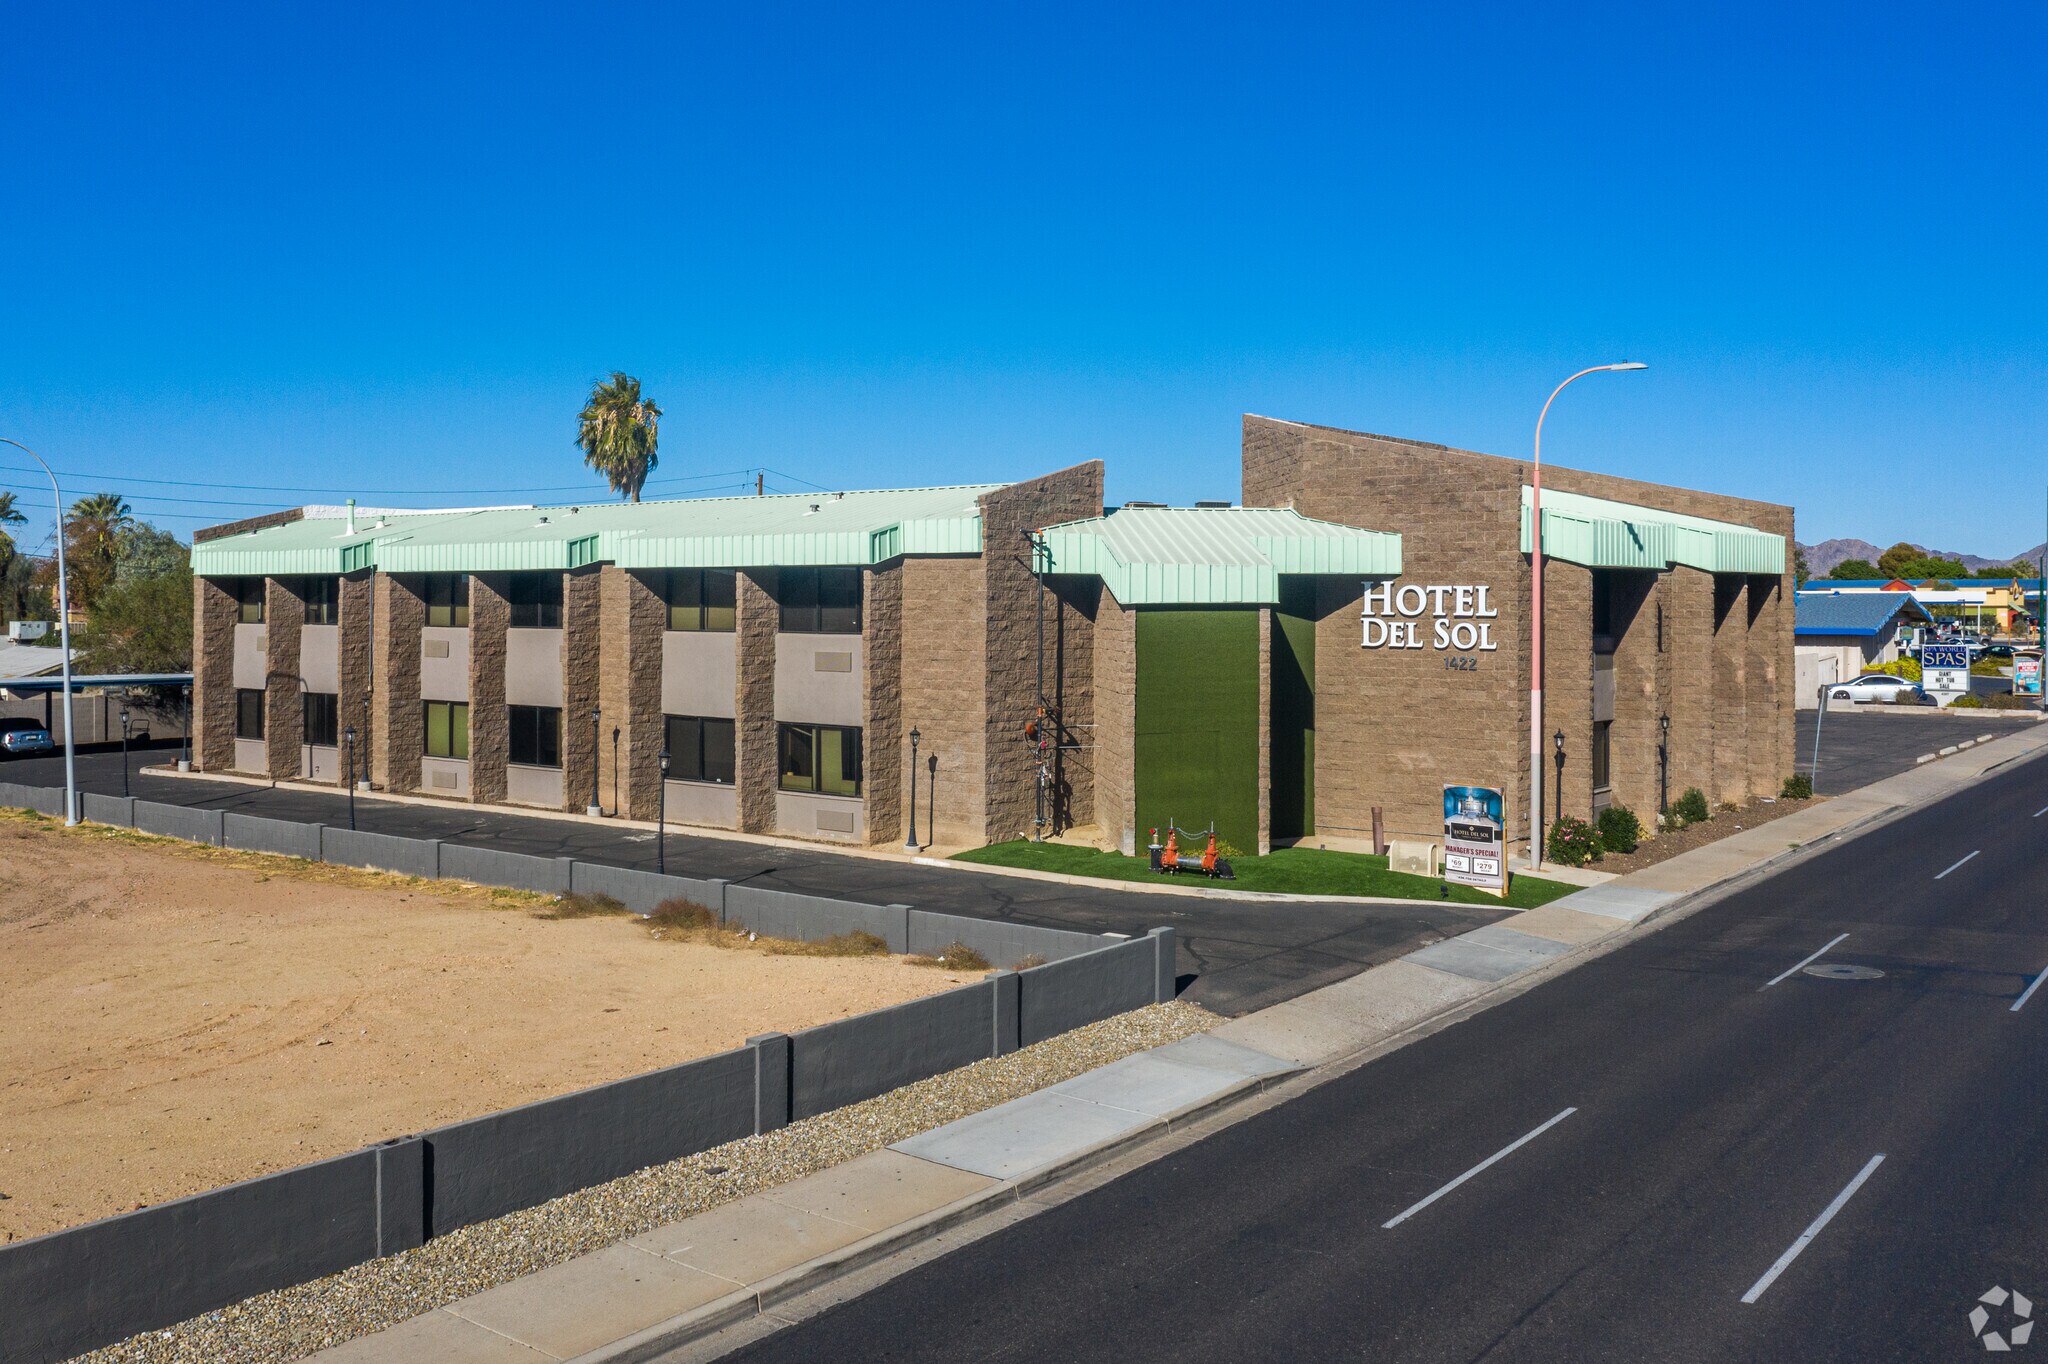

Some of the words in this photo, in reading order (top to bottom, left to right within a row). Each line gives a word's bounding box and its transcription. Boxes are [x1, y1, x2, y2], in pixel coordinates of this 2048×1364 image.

[1361, 581, 1498, 617] HOTEL
[1360, 617, 1424, 649] DEL
[1433, 618, 1497, 650] SOL
[1443, 656, 1478, 671] 1422
[1924, 652, 1966, 665] SPAS
[1445, 844, 1475, 855] MANAGER'S
[1475, 848, 1499, 857] SPECIAL!
